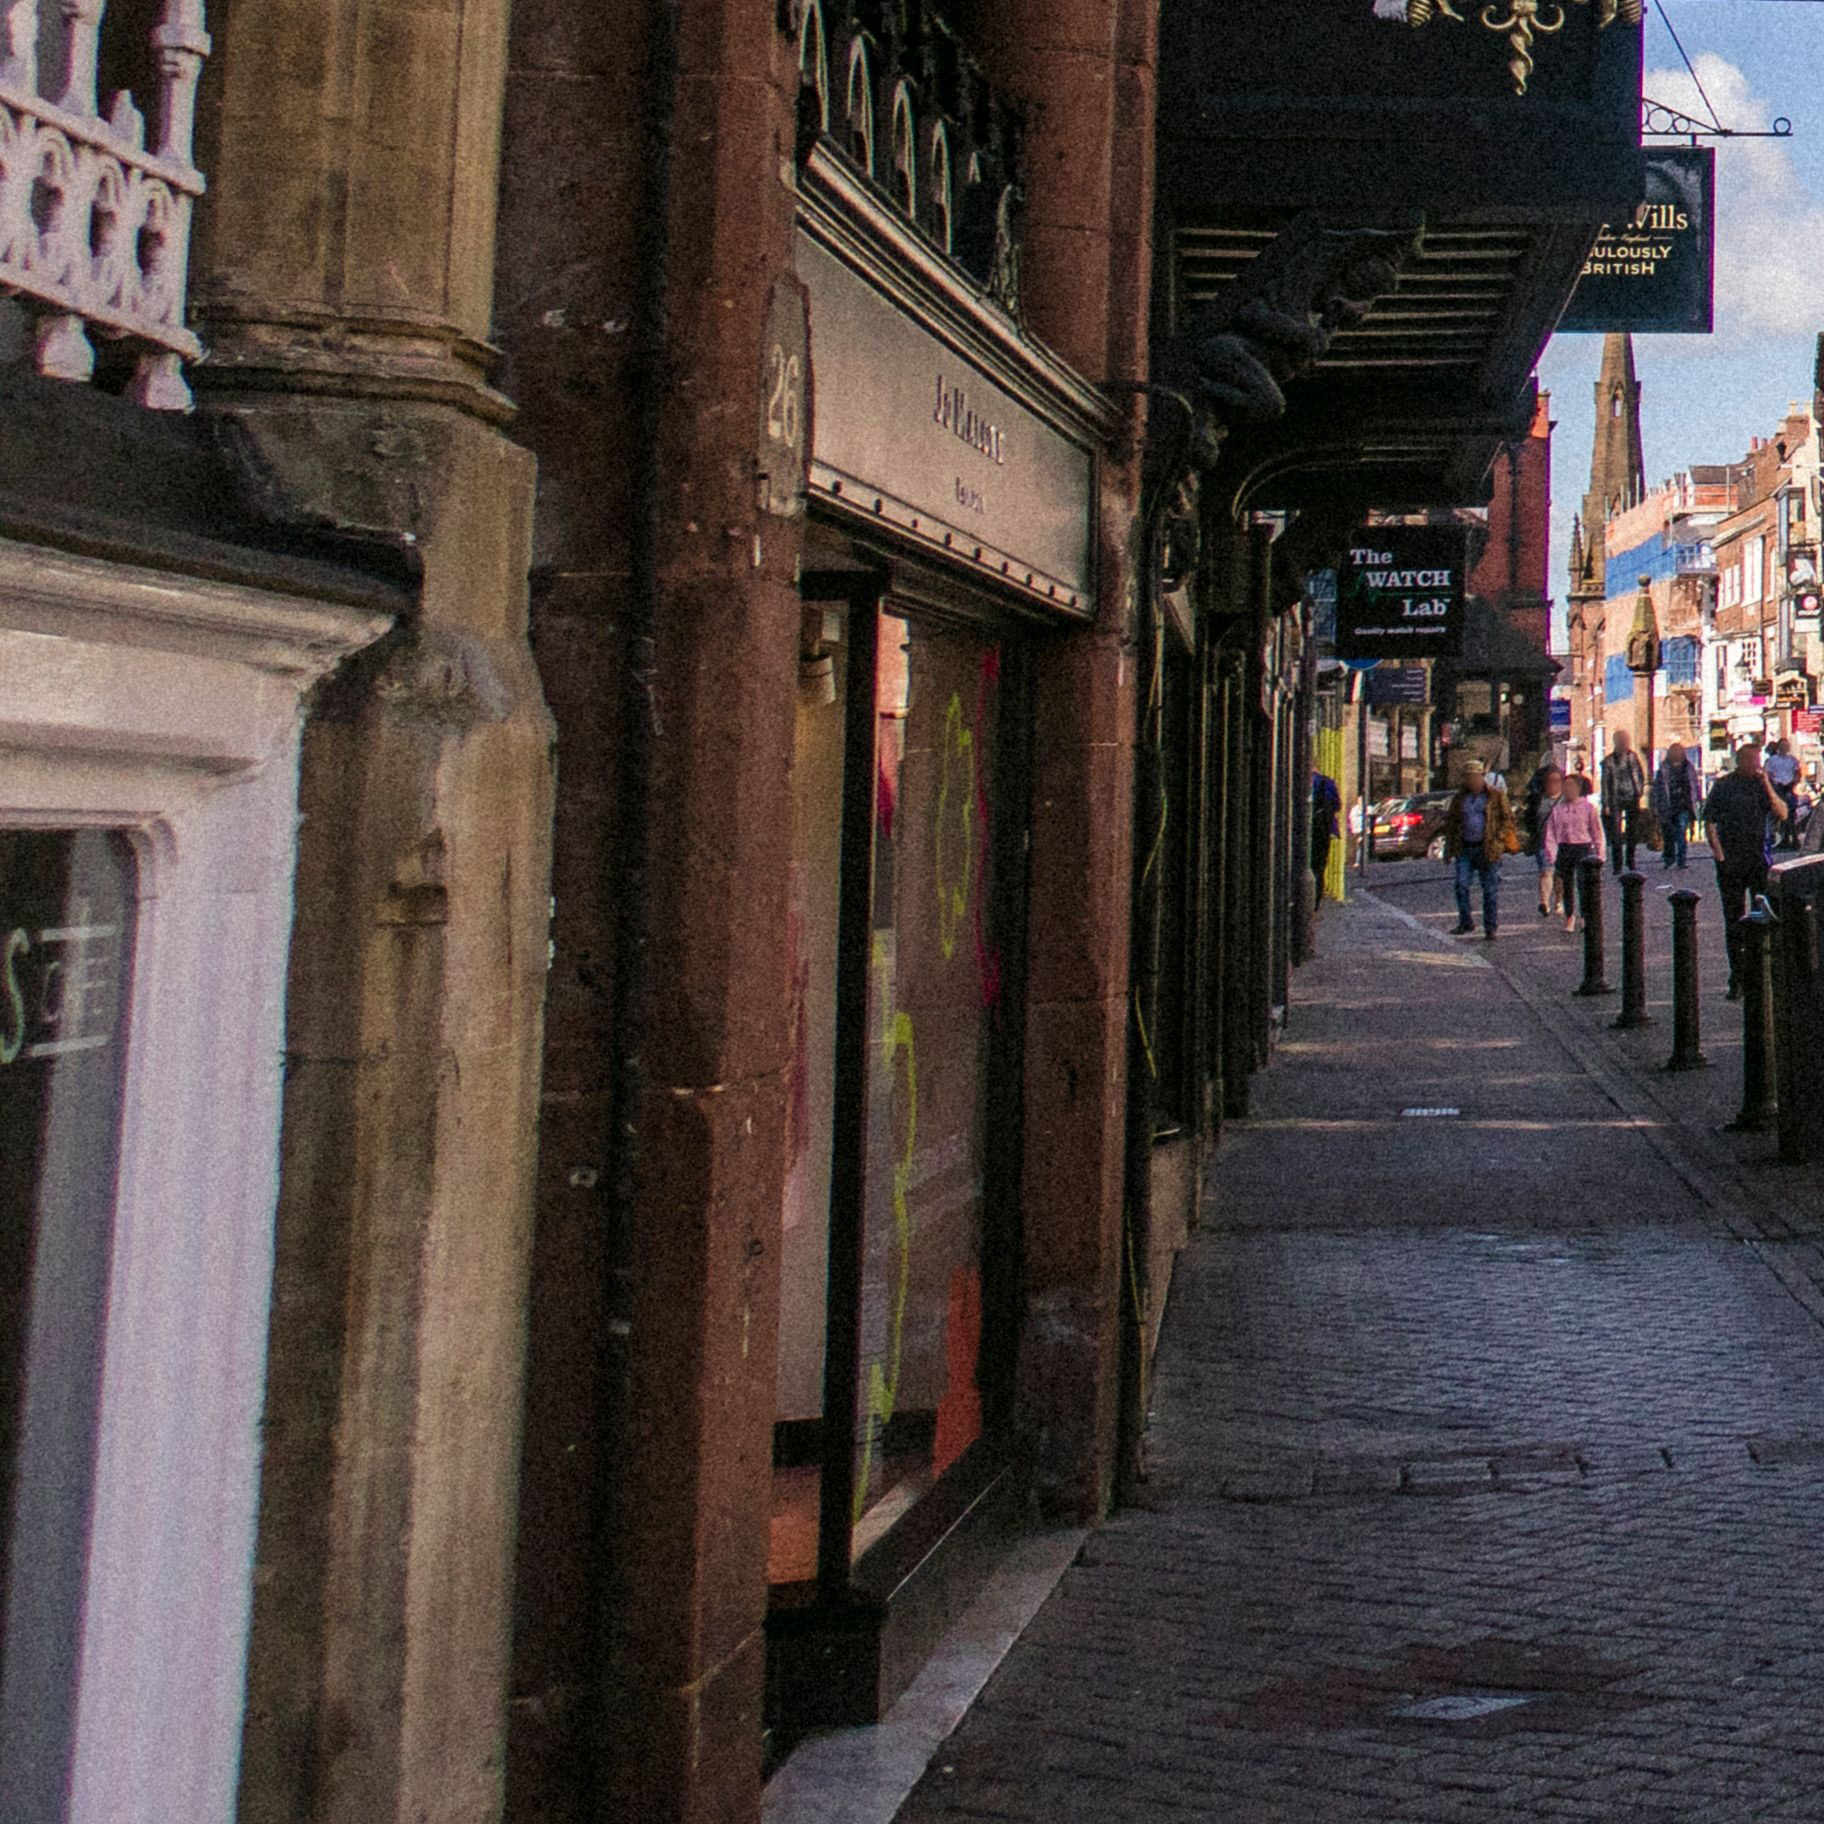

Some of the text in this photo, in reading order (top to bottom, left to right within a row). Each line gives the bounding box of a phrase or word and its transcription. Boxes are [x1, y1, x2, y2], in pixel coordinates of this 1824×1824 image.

[1589, 245, 1673, 259] ULOUSLY
[1581, 260, 1655, 275] BRITISH
[768, 343, 798, 448] 26
[1350, 548, 1393, 565] The
[1365, 569, 1452, 588] WATCH
